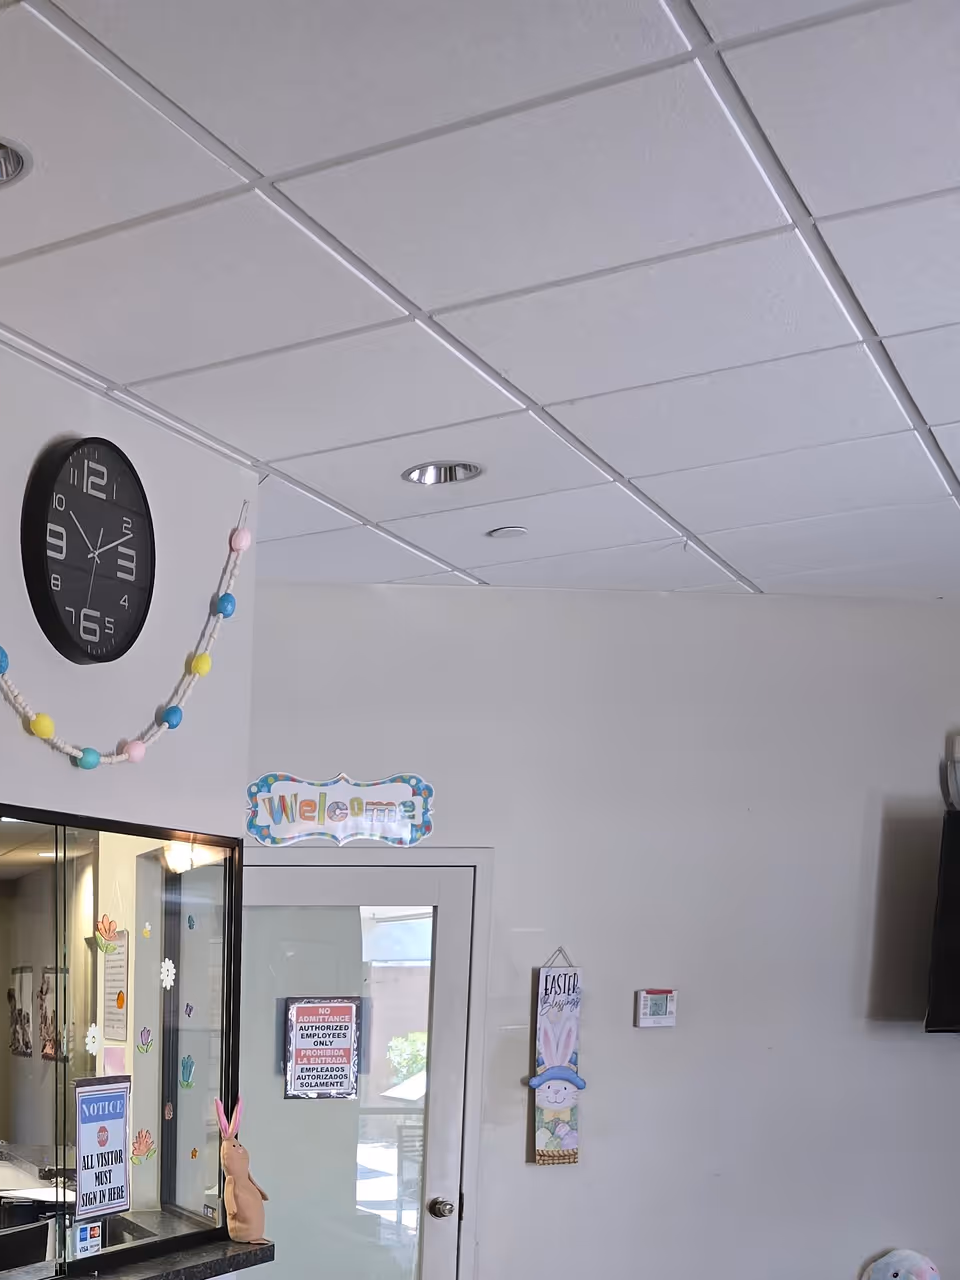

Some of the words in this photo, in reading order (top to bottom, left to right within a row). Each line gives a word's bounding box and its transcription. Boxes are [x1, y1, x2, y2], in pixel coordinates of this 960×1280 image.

[69, 467, 78, 486] 11
[82, 459, 107, 500] 12
[52, 491, 66, 512] 10
[122, 516, 132, 534] 2
[46, 522, 67, 560] 9
[117, 546, 136, 582] 3
[50, 573, 61, 591] 8
[119, 594, 129, 610] 4
[65, 606, 75, 625] 7
[80, 608, 101, 642] 6
[104, 616, 115, 634] 5
[261, 792, 416, 826] Welcome
[544, 972, 579, 996] EASTER
[540, 993, 582, 1016] Blessings
[82, 1100, 124, 1118] NOTICE
[97, 1131, 109, 1142] STOP
[82, 1154, 95, 1171] ALL
[96, 1149, 124, 1169] VISITOR
[94, 1169, 113, 1187] MUST
[81, 1191, 98, 1208] SIGN
[98, 1188, 107, 1205] IN
[108, 1185, 125, 1203] HERE
